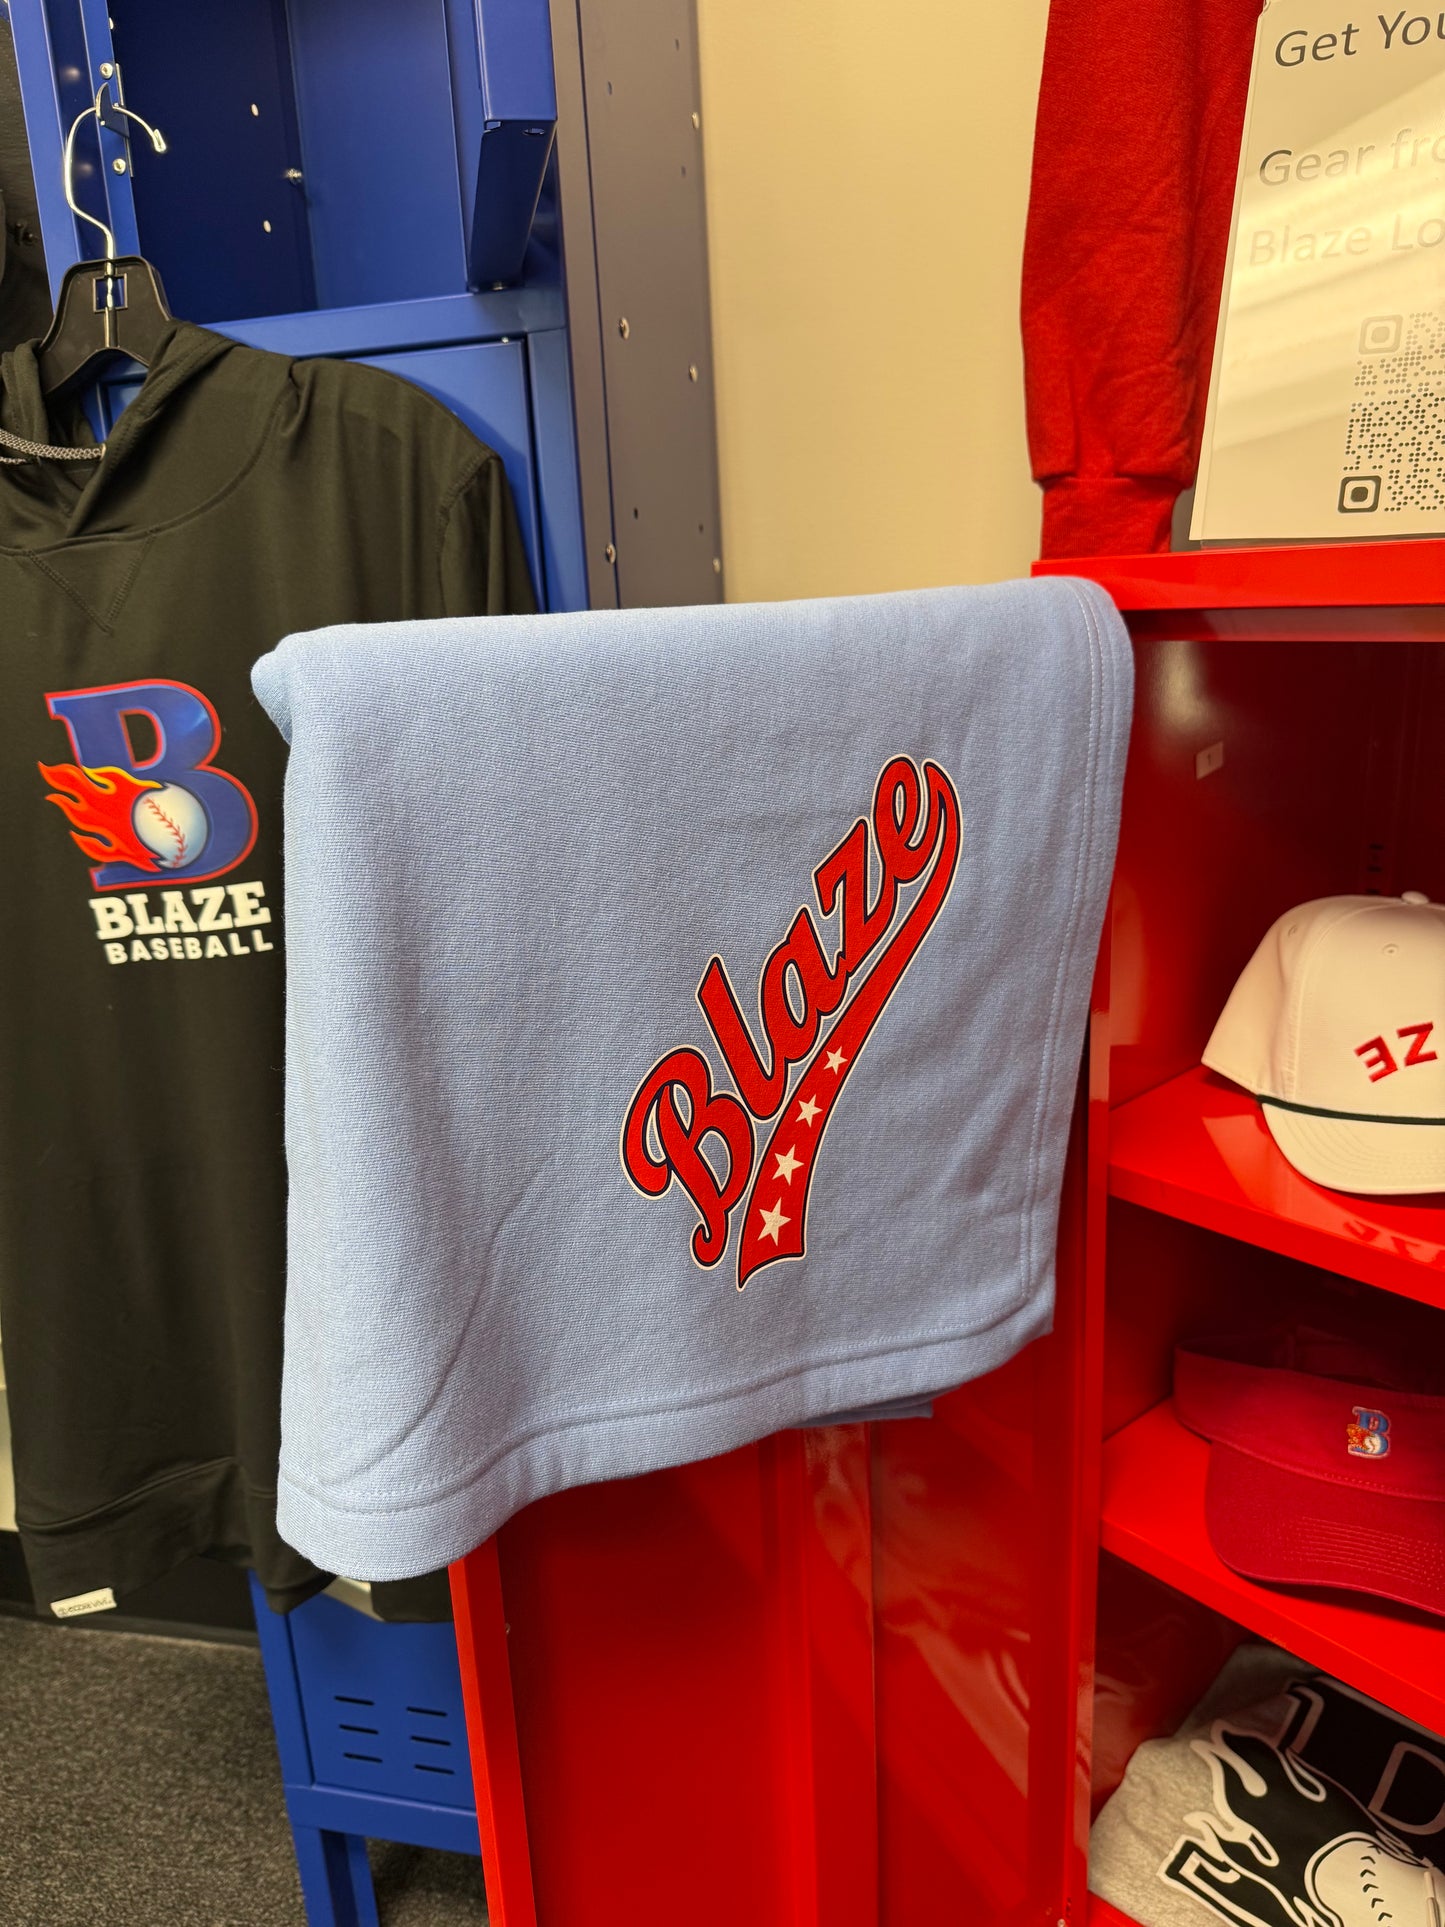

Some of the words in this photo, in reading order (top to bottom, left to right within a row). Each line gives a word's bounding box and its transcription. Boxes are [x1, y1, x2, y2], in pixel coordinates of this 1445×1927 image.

[1275, 23, 1360, 67] Get
[1259, 144, 1375, 186] Gear
[1249, 223, 1373, 267] Blaze
[1391, 213, 1445, 251] Lo
[88, 880, 272, 940] BLAZE
[104, 929, 274, 965] BASEBALL
[619, 753, 957, 1271] Blaze
